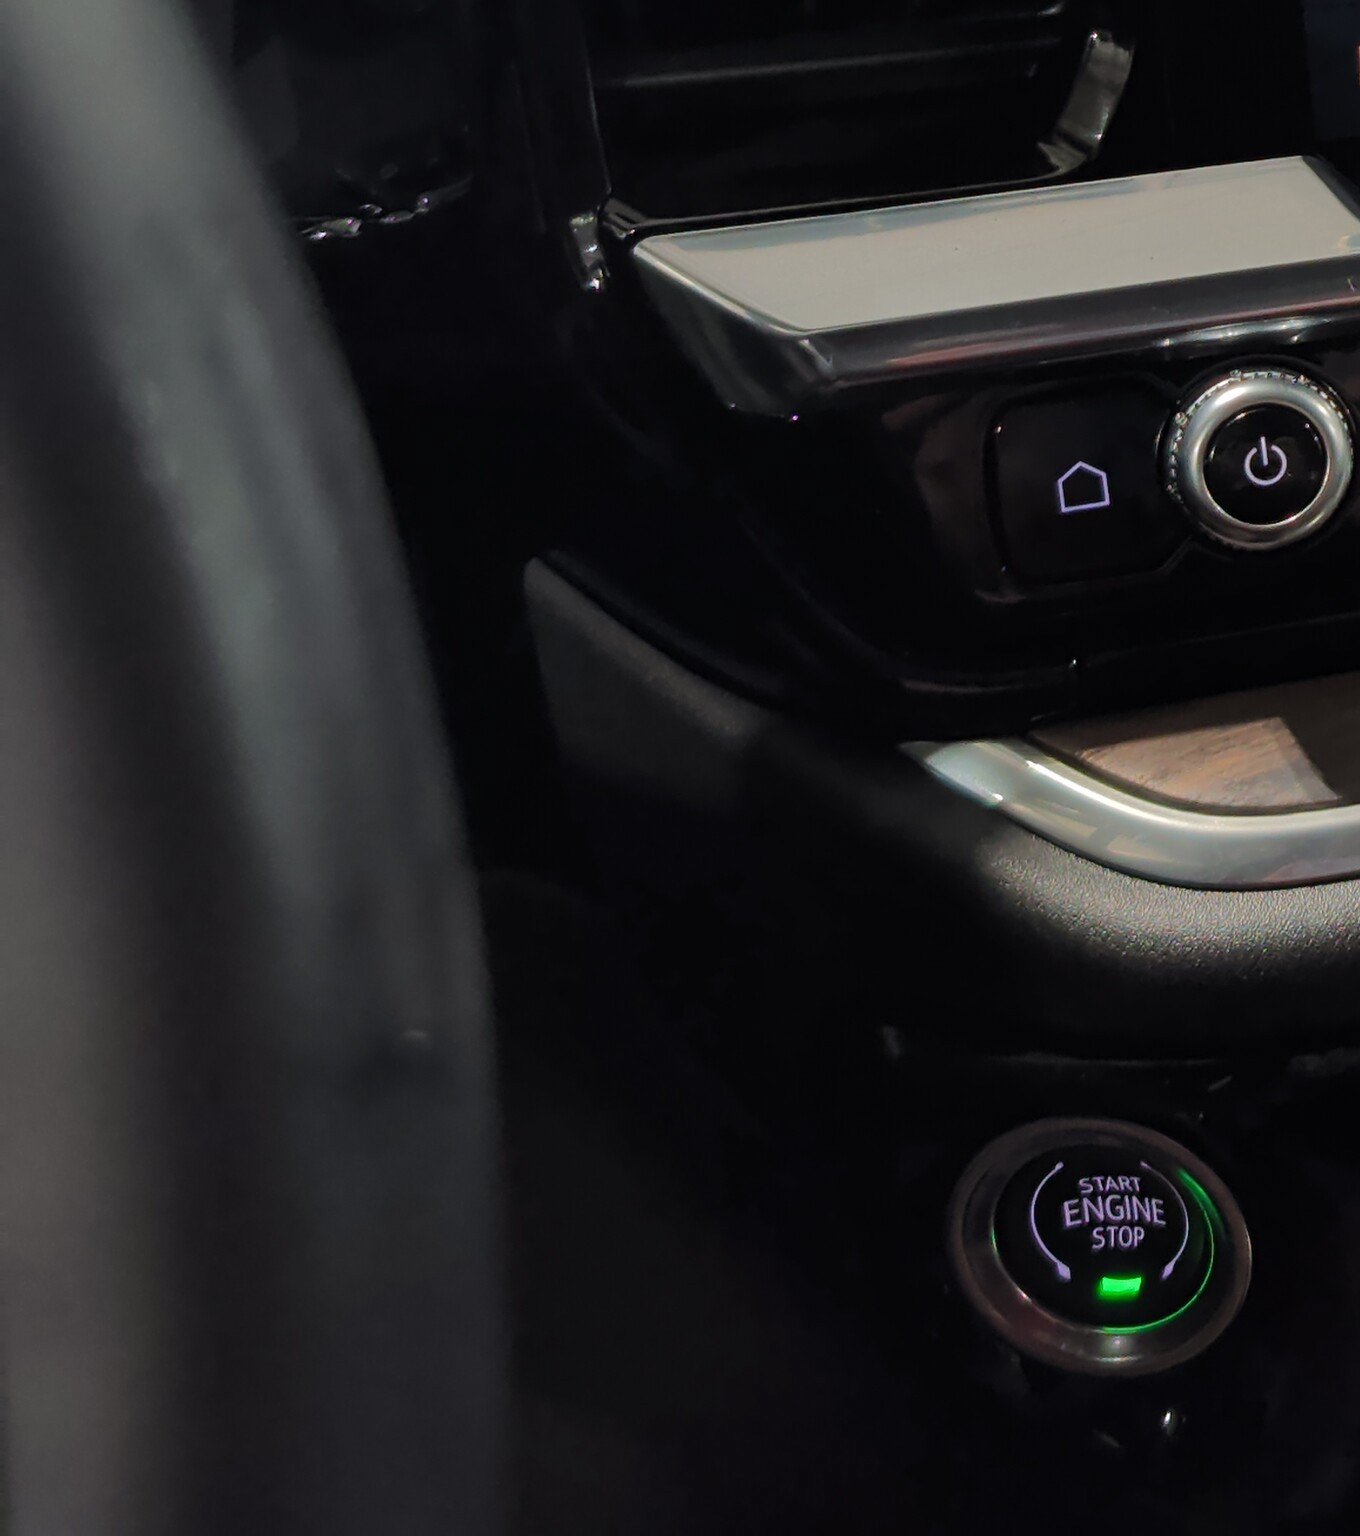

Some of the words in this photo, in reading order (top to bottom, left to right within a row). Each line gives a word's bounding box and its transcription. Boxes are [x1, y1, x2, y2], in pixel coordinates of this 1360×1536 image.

[1078, 1175, 1141, 1195] START
[1062, 1194, 1167, 1227] ENGINE
[1091, 1225, 1145, 1249] STOP
